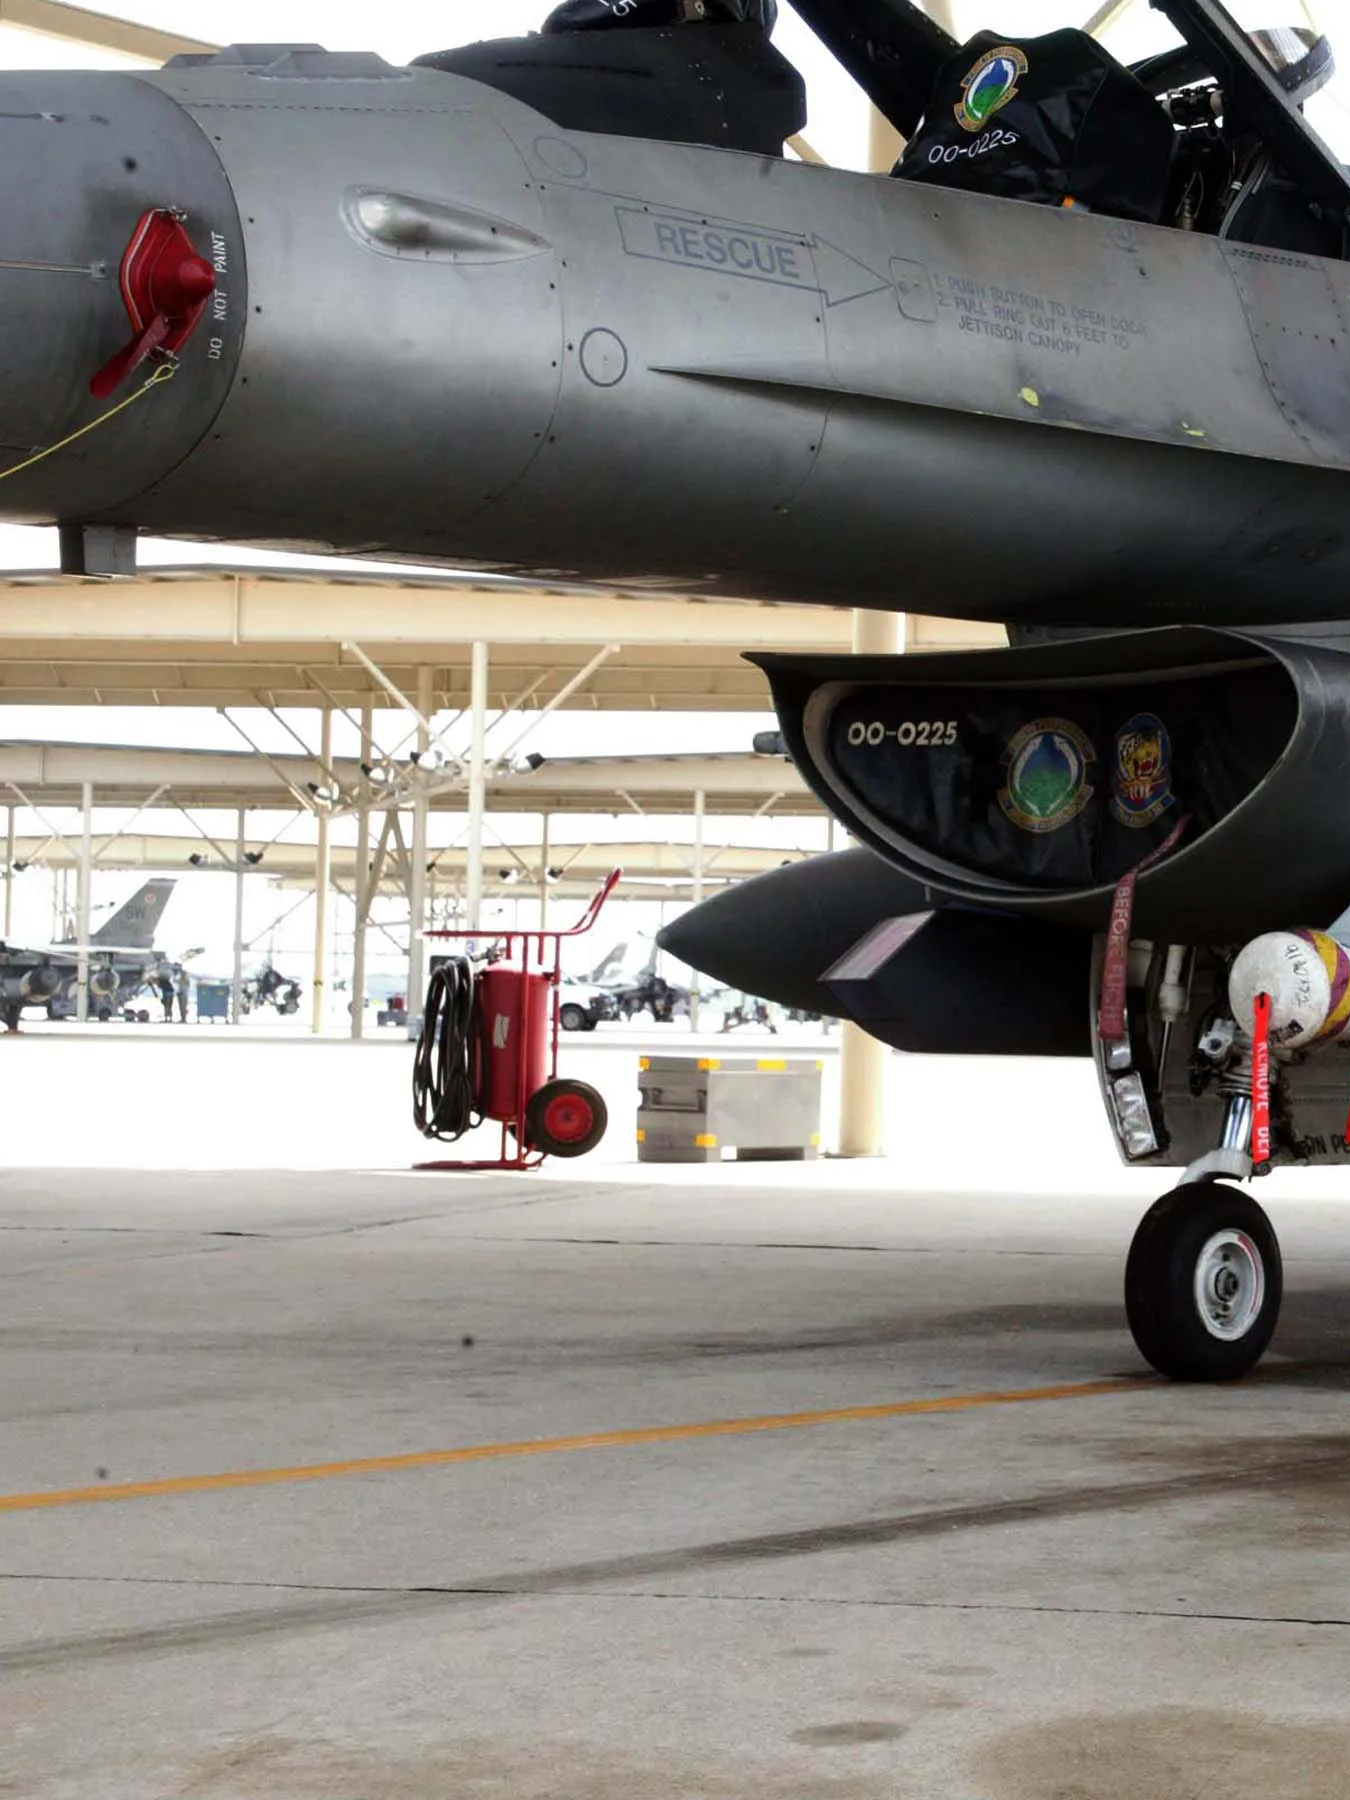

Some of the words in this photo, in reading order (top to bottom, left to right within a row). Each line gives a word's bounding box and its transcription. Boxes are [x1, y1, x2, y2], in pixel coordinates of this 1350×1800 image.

[928, 130, 1020, 164] 00-0225
[211, 231, 227, 273] PAINT
[653, 222, 800, 279] RESCUE
[213, 288, 227, 321] NOT
[990, 286, 1044, 313] BUTTON
[1050, 300, 1067, 318] TO
[954, 296, 988, 318] PULL
[1030, 313, 1056, 333] OUT
[1075, 324, 1106, 346] FEET
[1113, 332, 1129, 350] TO
[958, 315, 1024, 344] JETTISON
[1028, 332, 1082, 357] CANOPY
[208, 337, 223, 360] DO
[847, 721, 958, 746] 00-0225
[1256, 1042, 1269, 1111] REMOVE
